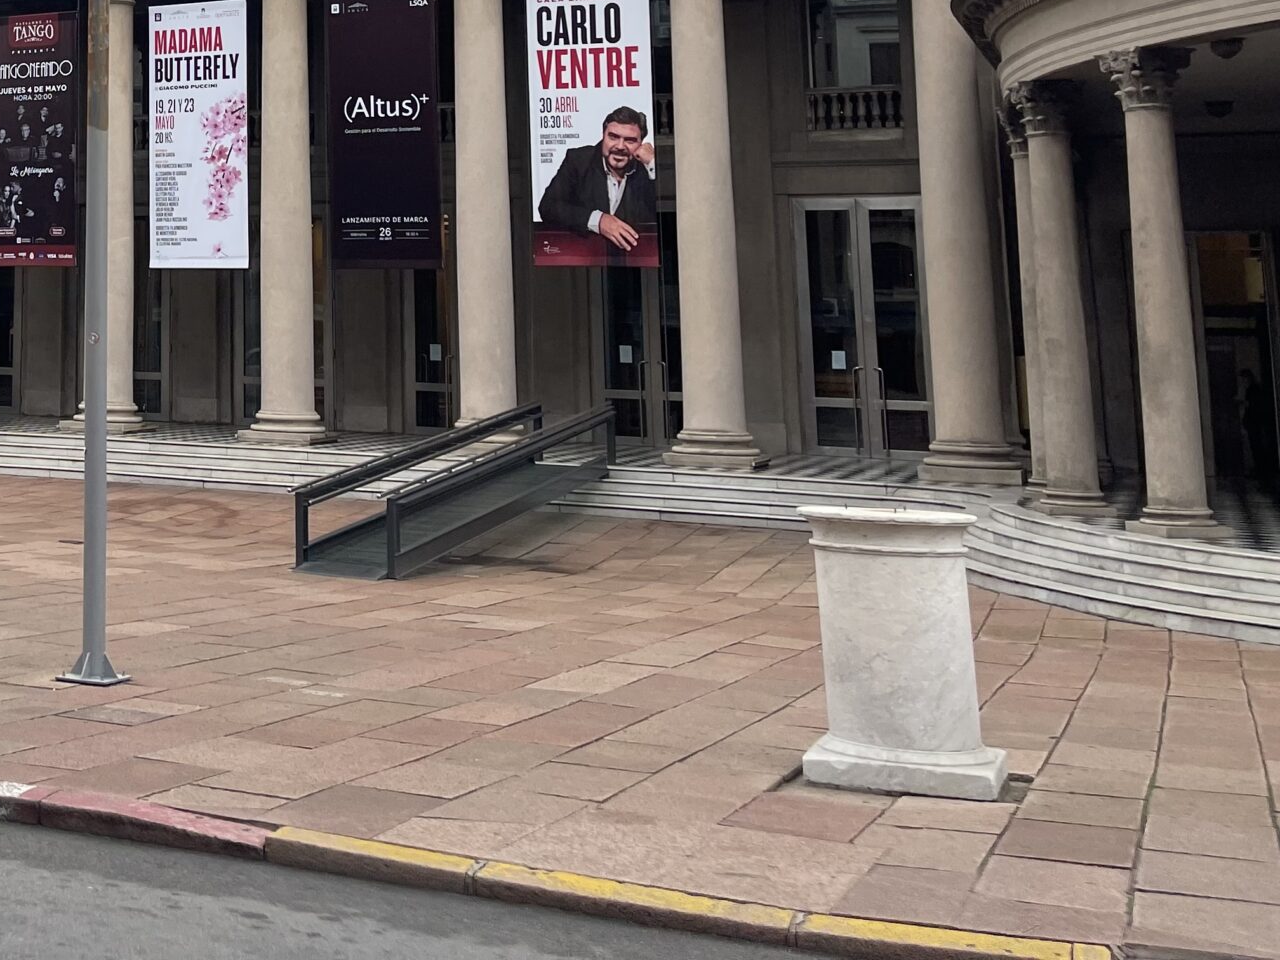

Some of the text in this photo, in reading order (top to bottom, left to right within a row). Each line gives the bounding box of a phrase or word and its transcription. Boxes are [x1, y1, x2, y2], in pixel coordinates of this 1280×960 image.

[536, 2, 621, 46] CARLO
[14, 24, 54, 42] TANGO
[154, 26, 223, 55] MADAMA
[155, 54, 240, 83] BUTTERFLY
[536, 46, 640, 90] VENTRE
[0, 87, 26, 95] JUEVES
[46, 84, 67, 92] MAYO
[168, 99, 176, 113] 21
[178, 98, 182, 112] Y
[184, 98, 194, 112] 23
[540, 96, 579, 113] 30 ABRIL
[155, 115, 175, 130] MAYO
[540, 115, 561, 128] 18:30
[155, 132, 164, 144] 20
[379, 227, 392, 237] 26
